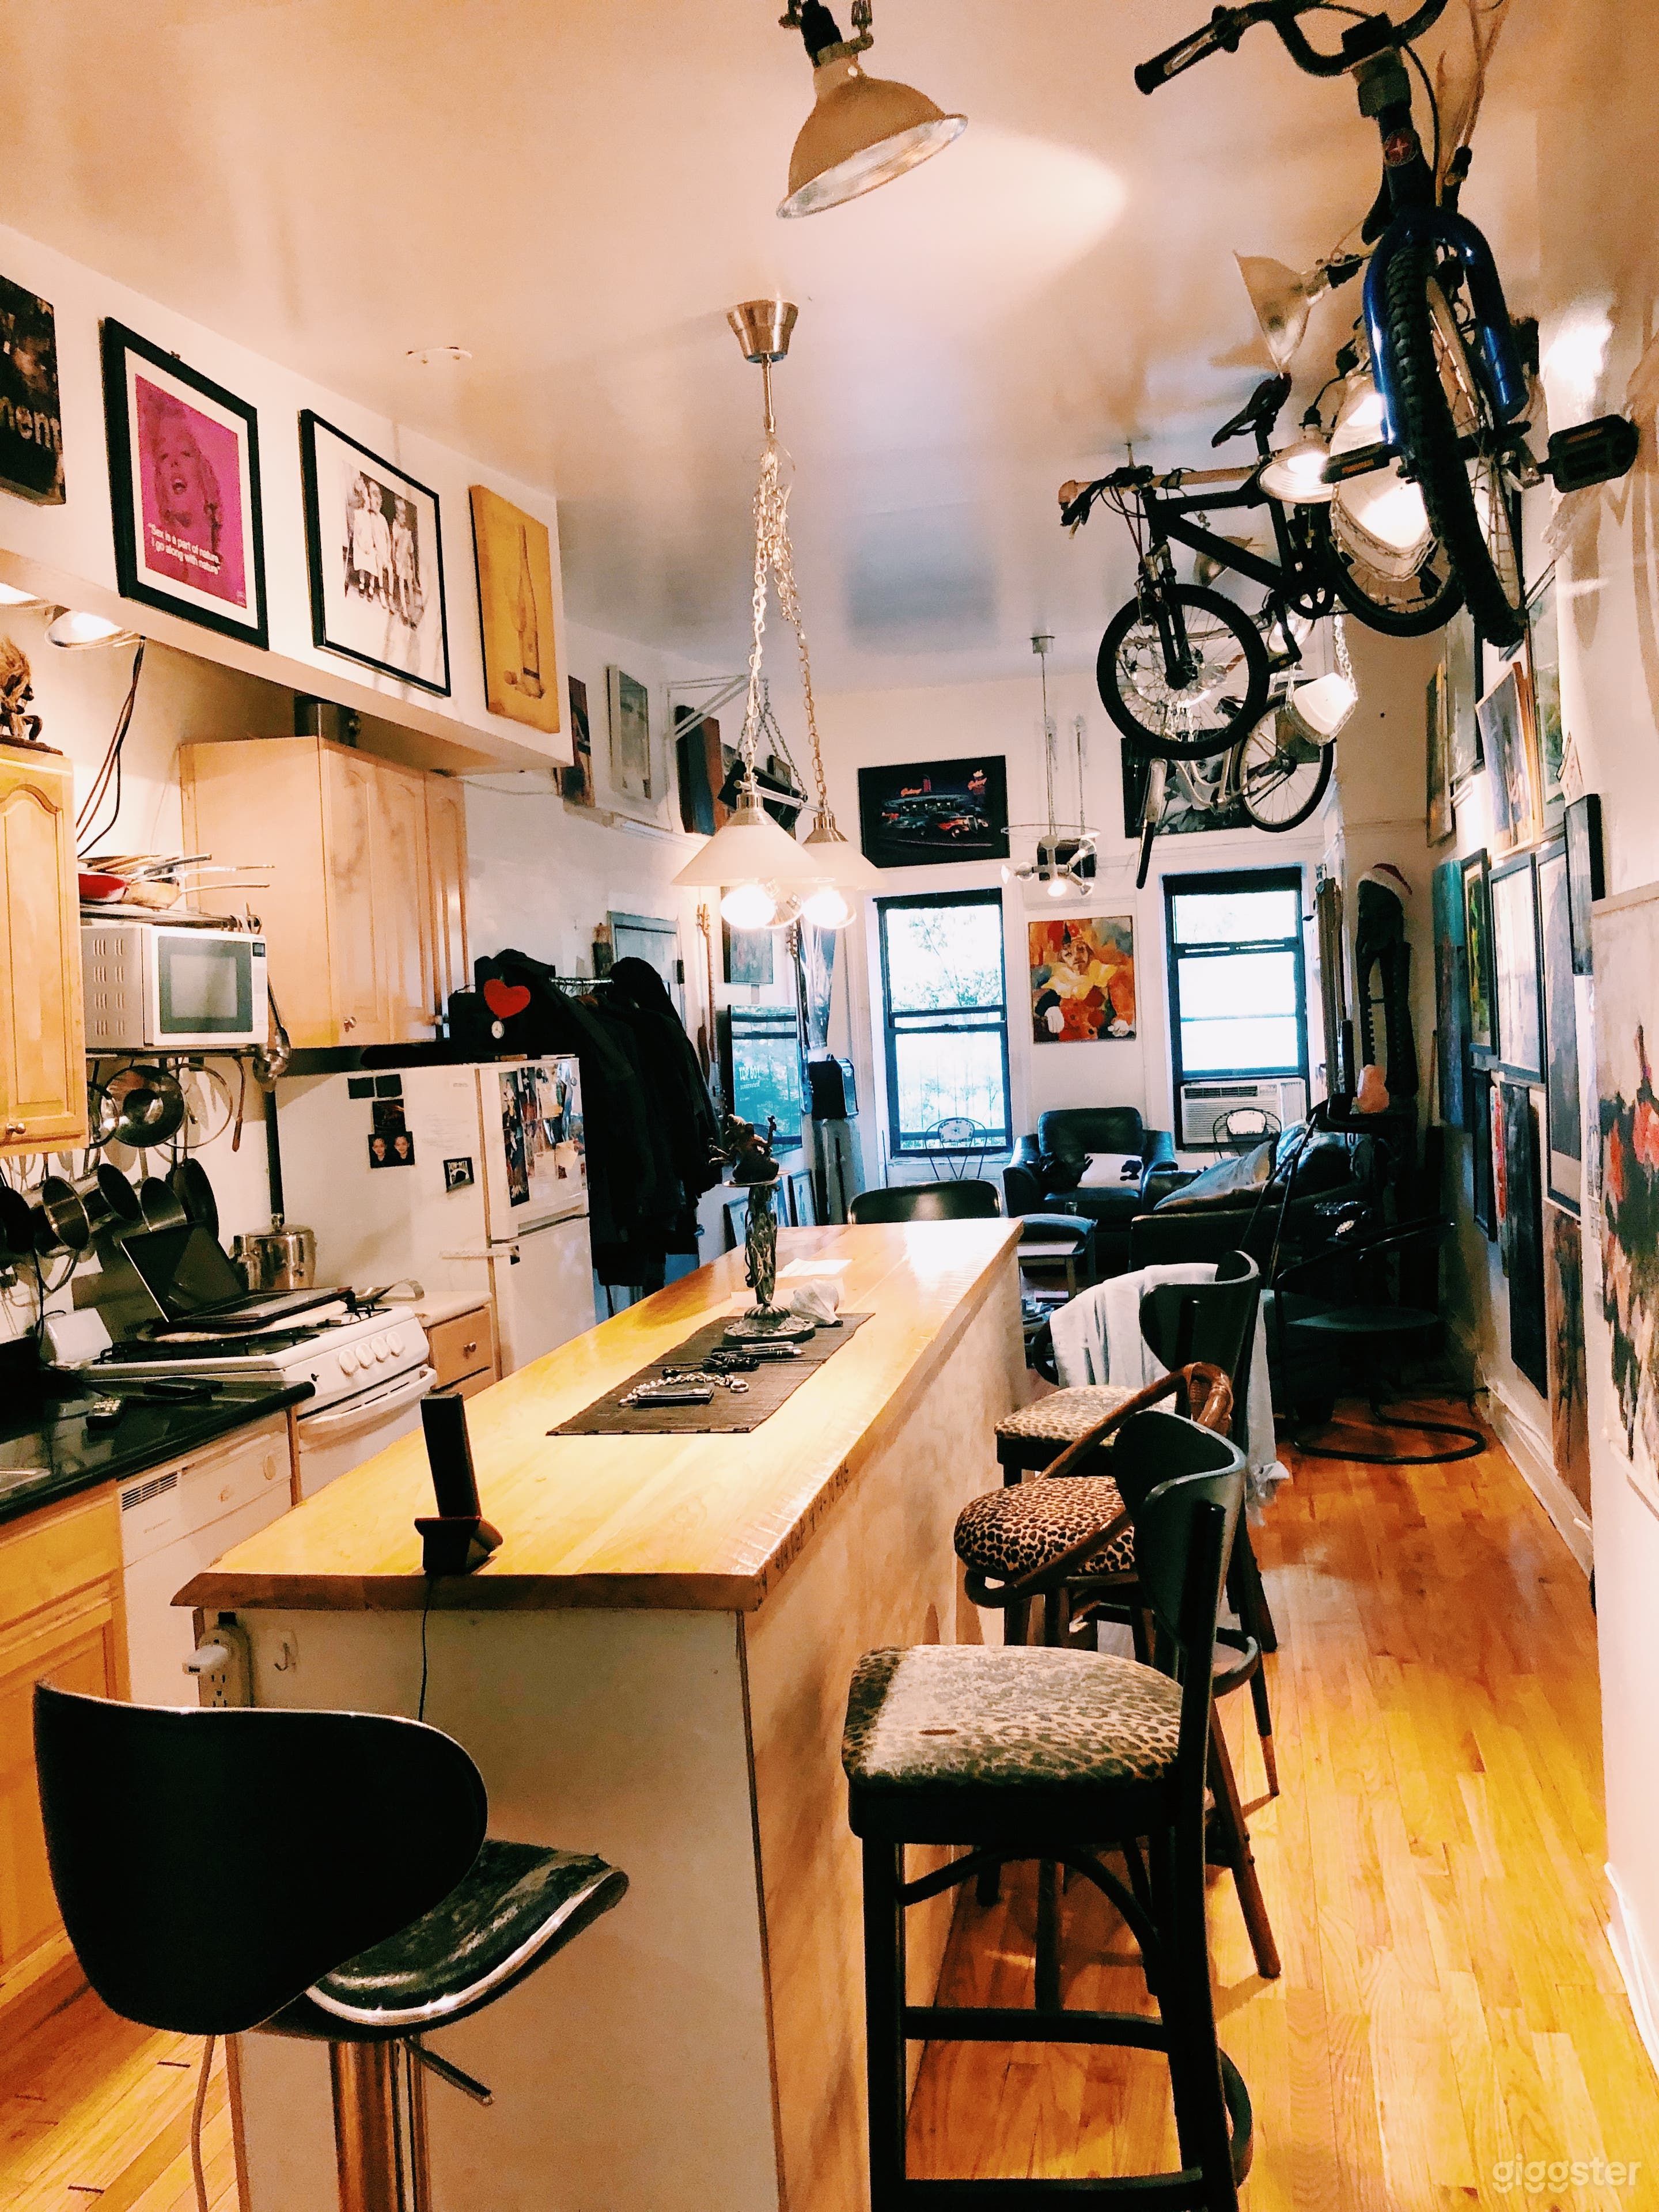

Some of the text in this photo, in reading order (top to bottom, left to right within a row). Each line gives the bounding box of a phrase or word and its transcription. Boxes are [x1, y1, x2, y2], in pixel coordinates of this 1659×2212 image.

[156, 540, 165, 552] go
[165, 544, 184, 562] along
[184, 554, 198, 566] with
[165, 531, 171, 542] is
[172, 535, 177, 546] a
[177, 538, 191, 551] part
[191, 545, 199, 554] of
